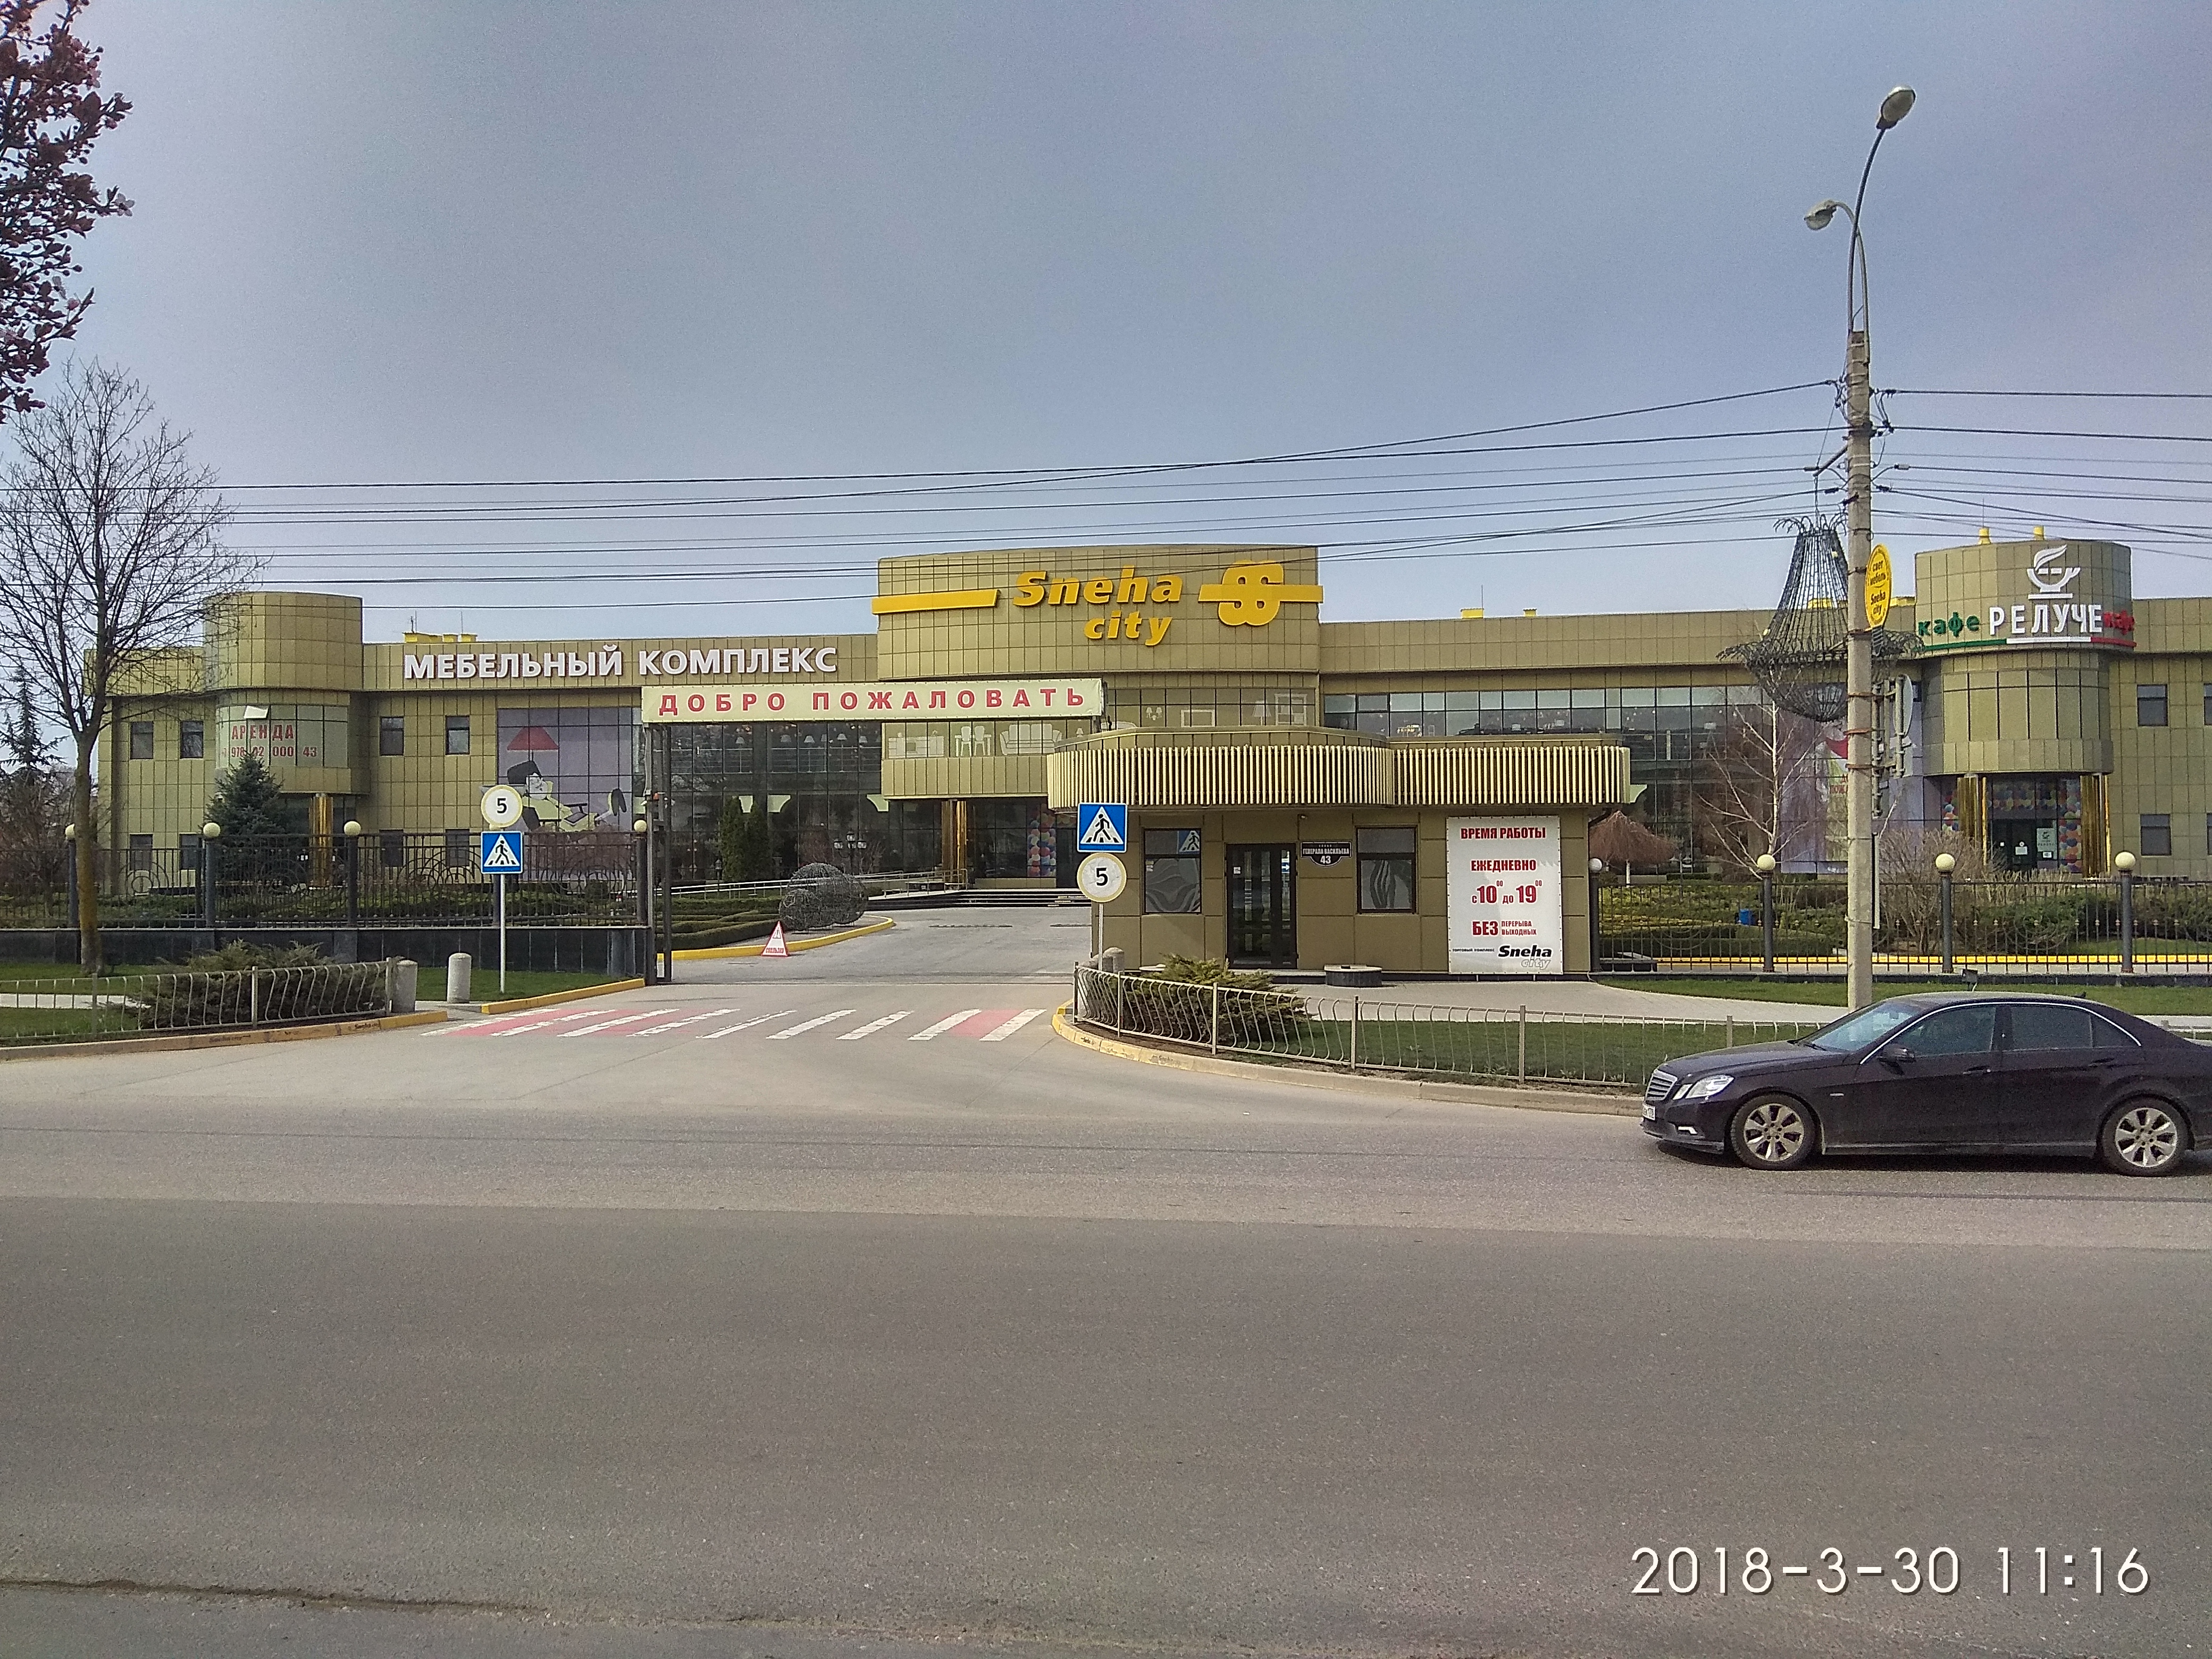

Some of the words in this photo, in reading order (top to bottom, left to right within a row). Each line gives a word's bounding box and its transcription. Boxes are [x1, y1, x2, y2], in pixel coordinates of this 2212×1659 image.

[1012, 565, 1183, 607] Sneha
[1083, 609, 1173, 646] city
[1917, 611, 1980, 638] кафе
[1989, 604, 2102, 635] РЕЛУЧЕ
[404, 643, 623, 679] МЕБЕЛЬНЫЙ
[639, 647, 837, 675] КОМПЛЕКС
[658, 693, 786, 716] ДОБРО
[812, 688, 1084, 711] ПОЖАЛОВАТЬ
[231, 724, 294, 741] АРЕНДА
[231, 747, 245, 758] 978
[272, 746, 294, 757] 000
[303, 746, 317, 757] 43
[497, 798, 507, 814] 5
[1461, 828, 1497, 839] ВРЕМЯ
[1500, 827, 1546, 839] РАБОТЫ
[1320, 855, 1331, 864] 43
[1471, 859, 1537, 873] ЕЖЕДНЕВНО
[1096, 867, 1108, 886] 5
[1477, 885, 1497, 903] 10
[1502, 895, 1514, 904] до
[1515, 885, 1537, 903] 19
[1472, 921, 1498, 935] БЕЗ
[1498, 945, 1552, 957] Sneha
[1521, 957, 1551, 970] city
